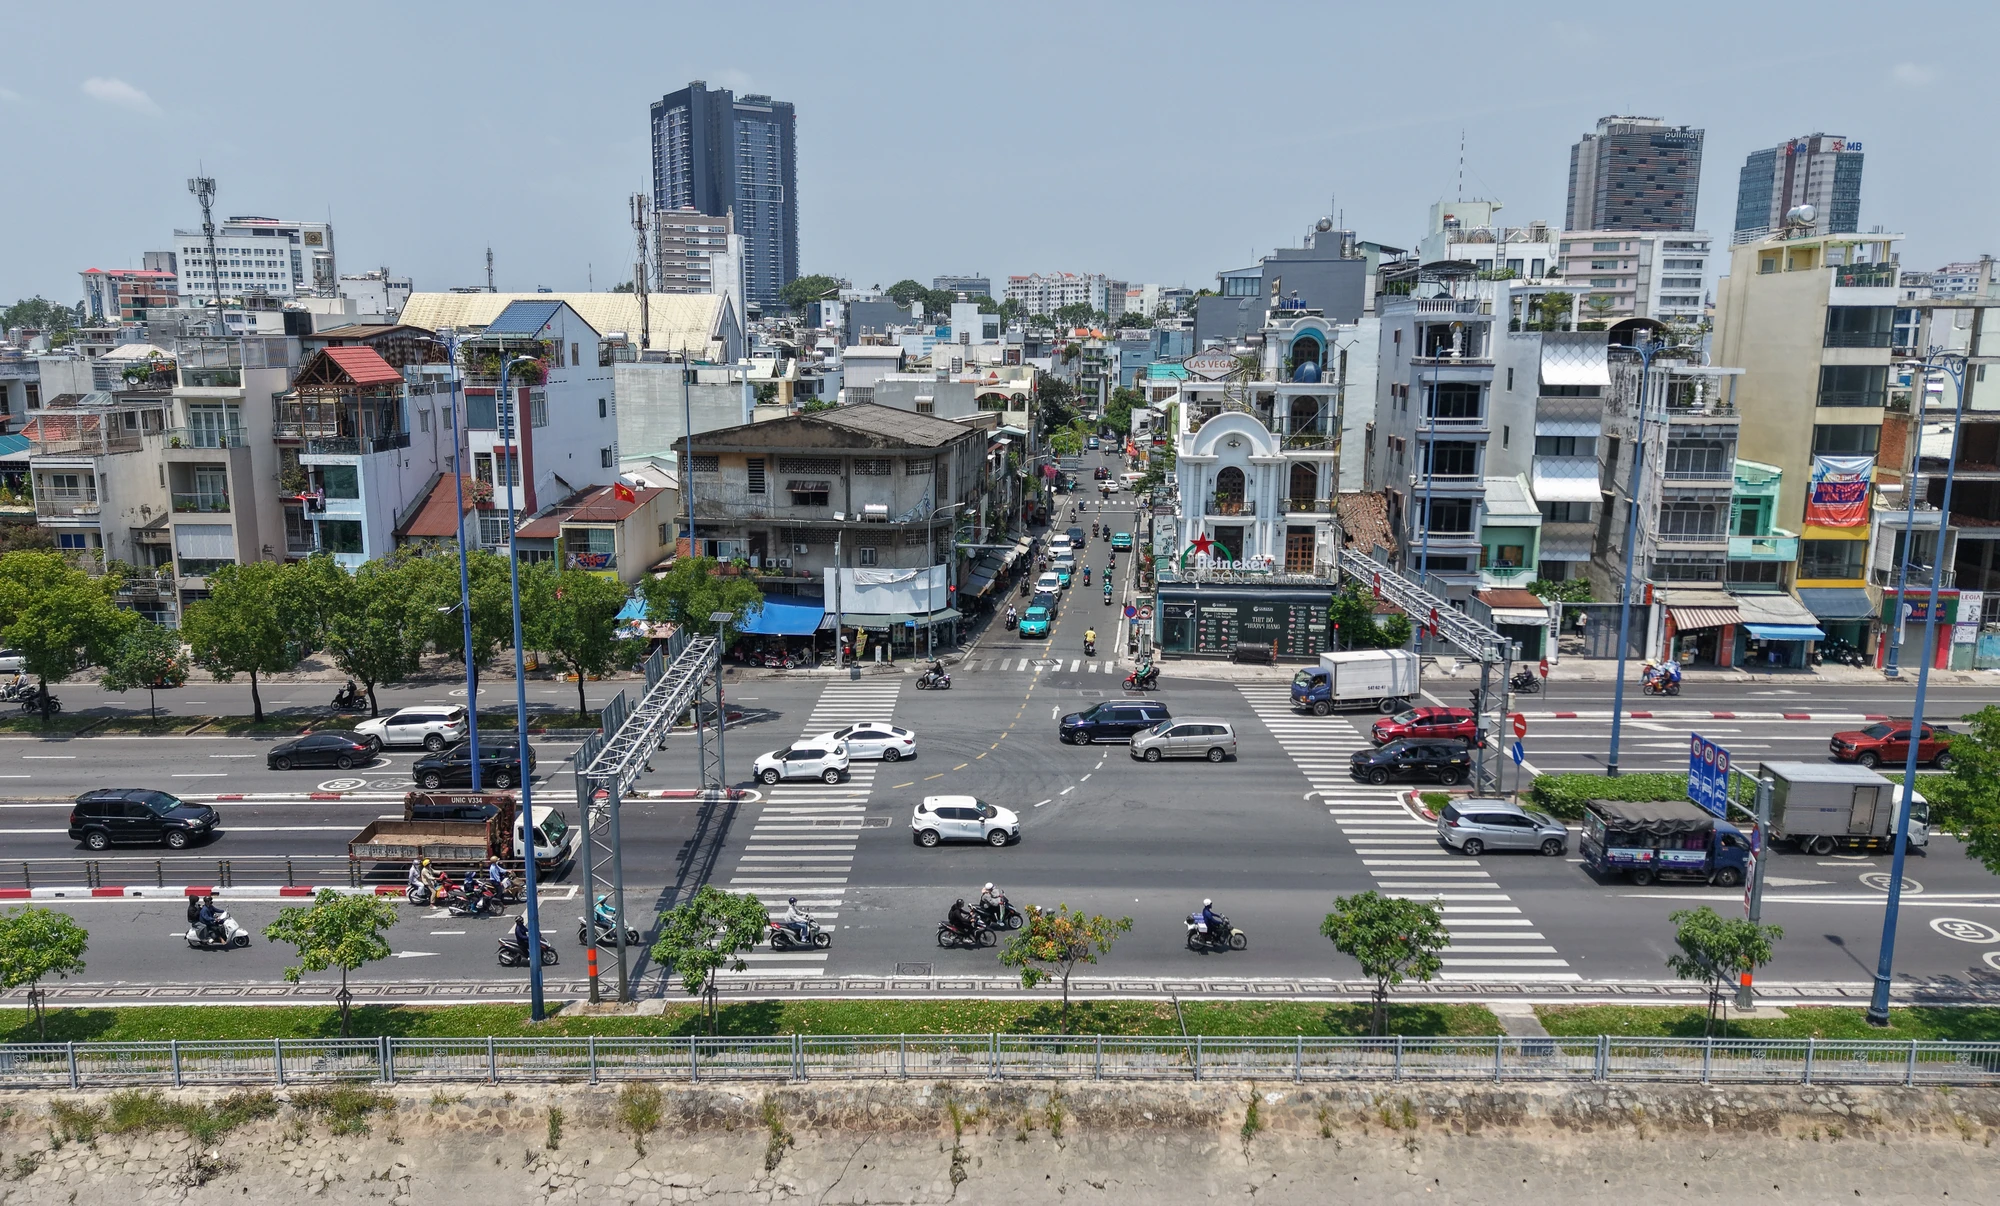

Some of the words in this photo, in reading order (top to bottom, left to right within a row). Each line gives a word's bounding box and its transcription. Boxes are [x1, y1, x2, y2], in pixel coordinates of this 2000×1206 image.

[1665, 131, 1699, 141] pullman
[1847, 142, 1862, 151] MB
[1189, 360, 1206, 369] LAS
[1207, 360, 1238, 369] VEGAS
[578, 553, 607, 567] Tiger
[1198, 556, 1269, 571] Heineken
[1719, 756, 1725, 768] 50
[1943, 923, 1985, 938] 50
